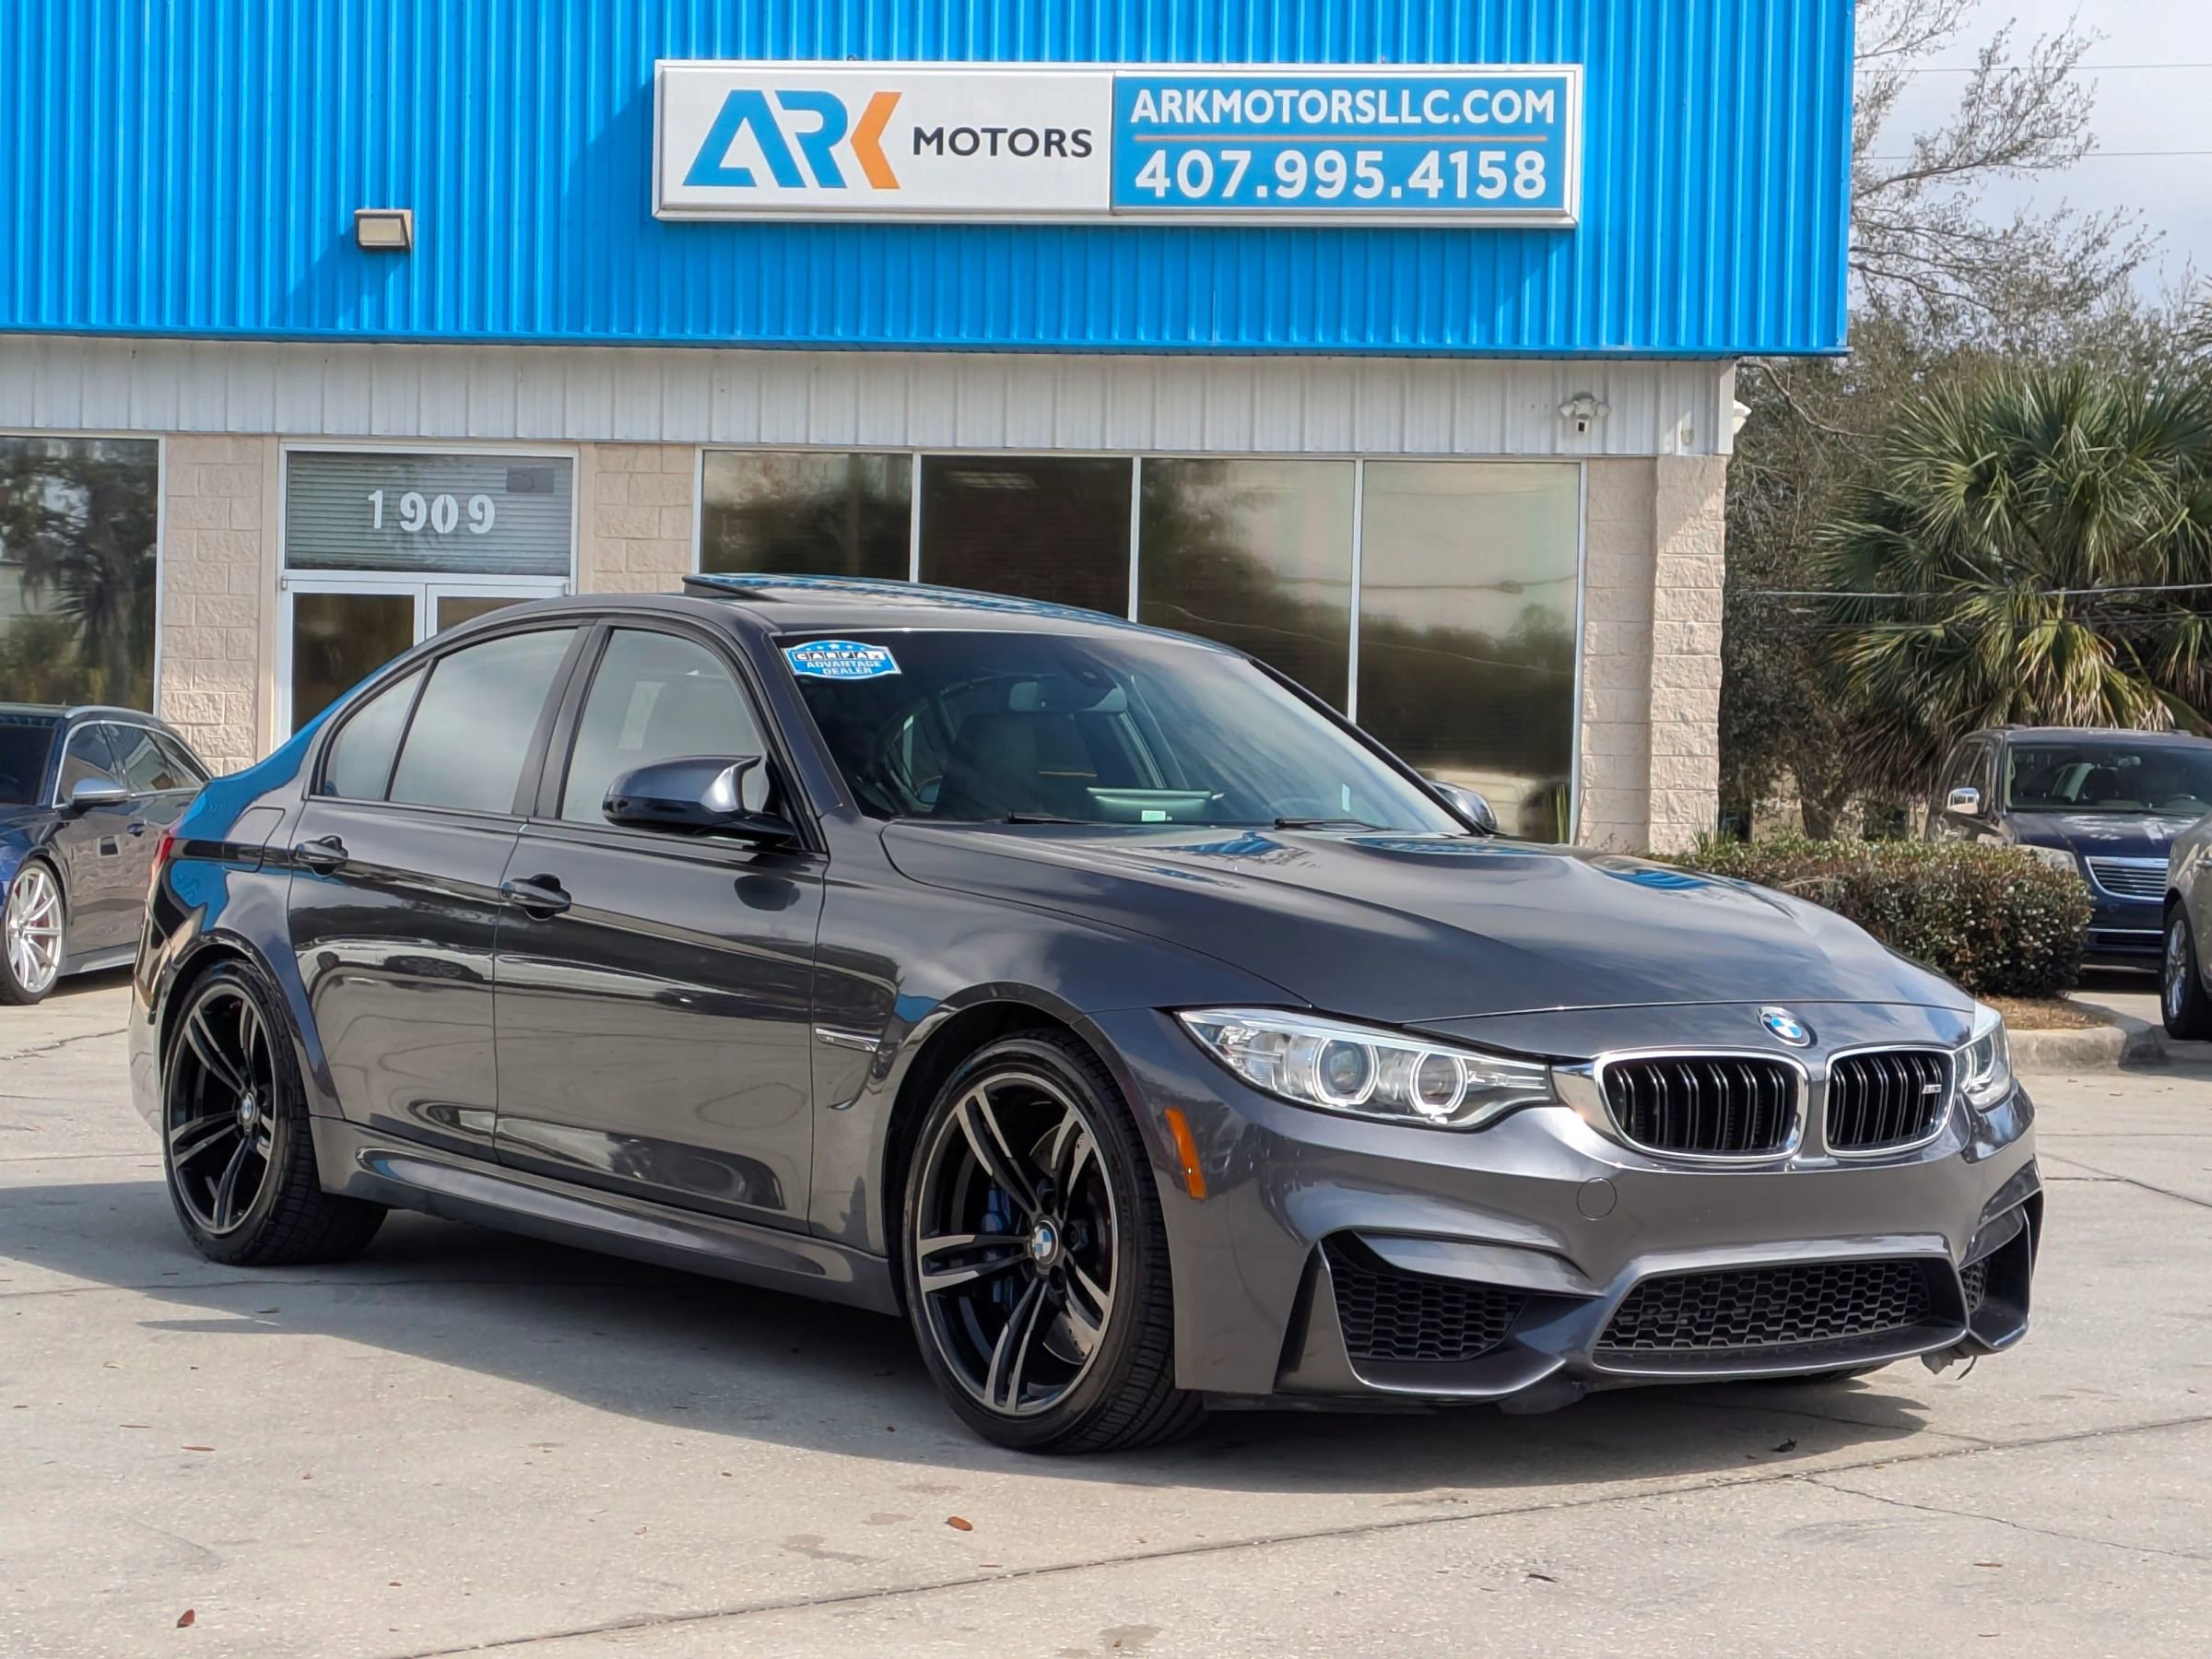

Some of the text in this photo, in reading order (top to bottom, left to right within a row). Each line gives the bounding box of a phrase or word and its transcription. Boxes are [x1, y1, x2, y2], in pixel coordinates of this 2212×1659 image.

[1130, 88, 1555, 124] ARKMOTORSLLC.COM
[682, 89, 1093, 190] ARK MOTORS
[1135, 149, 1547, 200] 407.995.4158
[368, 489, 496, 535] 1909
[806, 660, 882, 669] ADVANTAGE
[822, 667, 873, 676] DEALER
